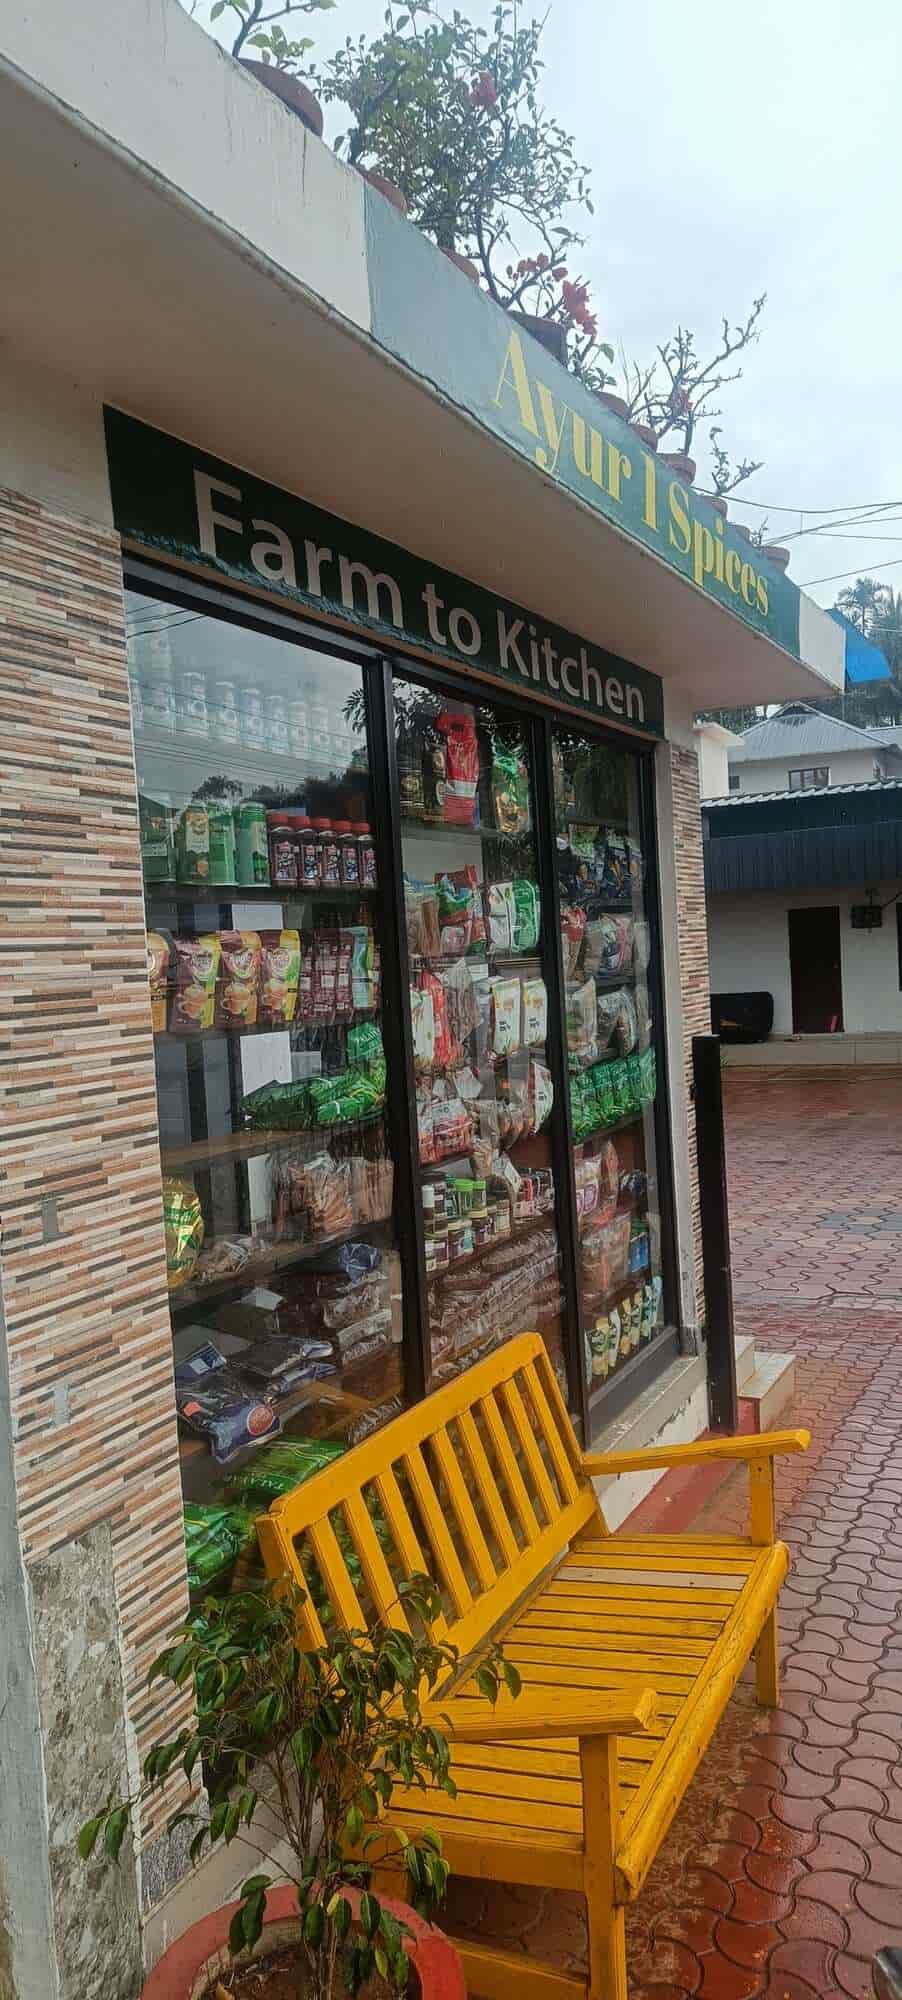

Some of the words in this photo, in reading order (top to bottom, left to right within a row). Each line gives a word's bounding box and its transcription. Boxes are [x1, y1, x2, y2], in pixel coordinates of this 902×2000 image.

[193, 468, 404, 629] Farm
[421, 583, 482, 656] to
[496, 608, 645, 723] Kitchen
[492, 328, 633, 505] Ayur
[668, 482, 769, 617] Spices
